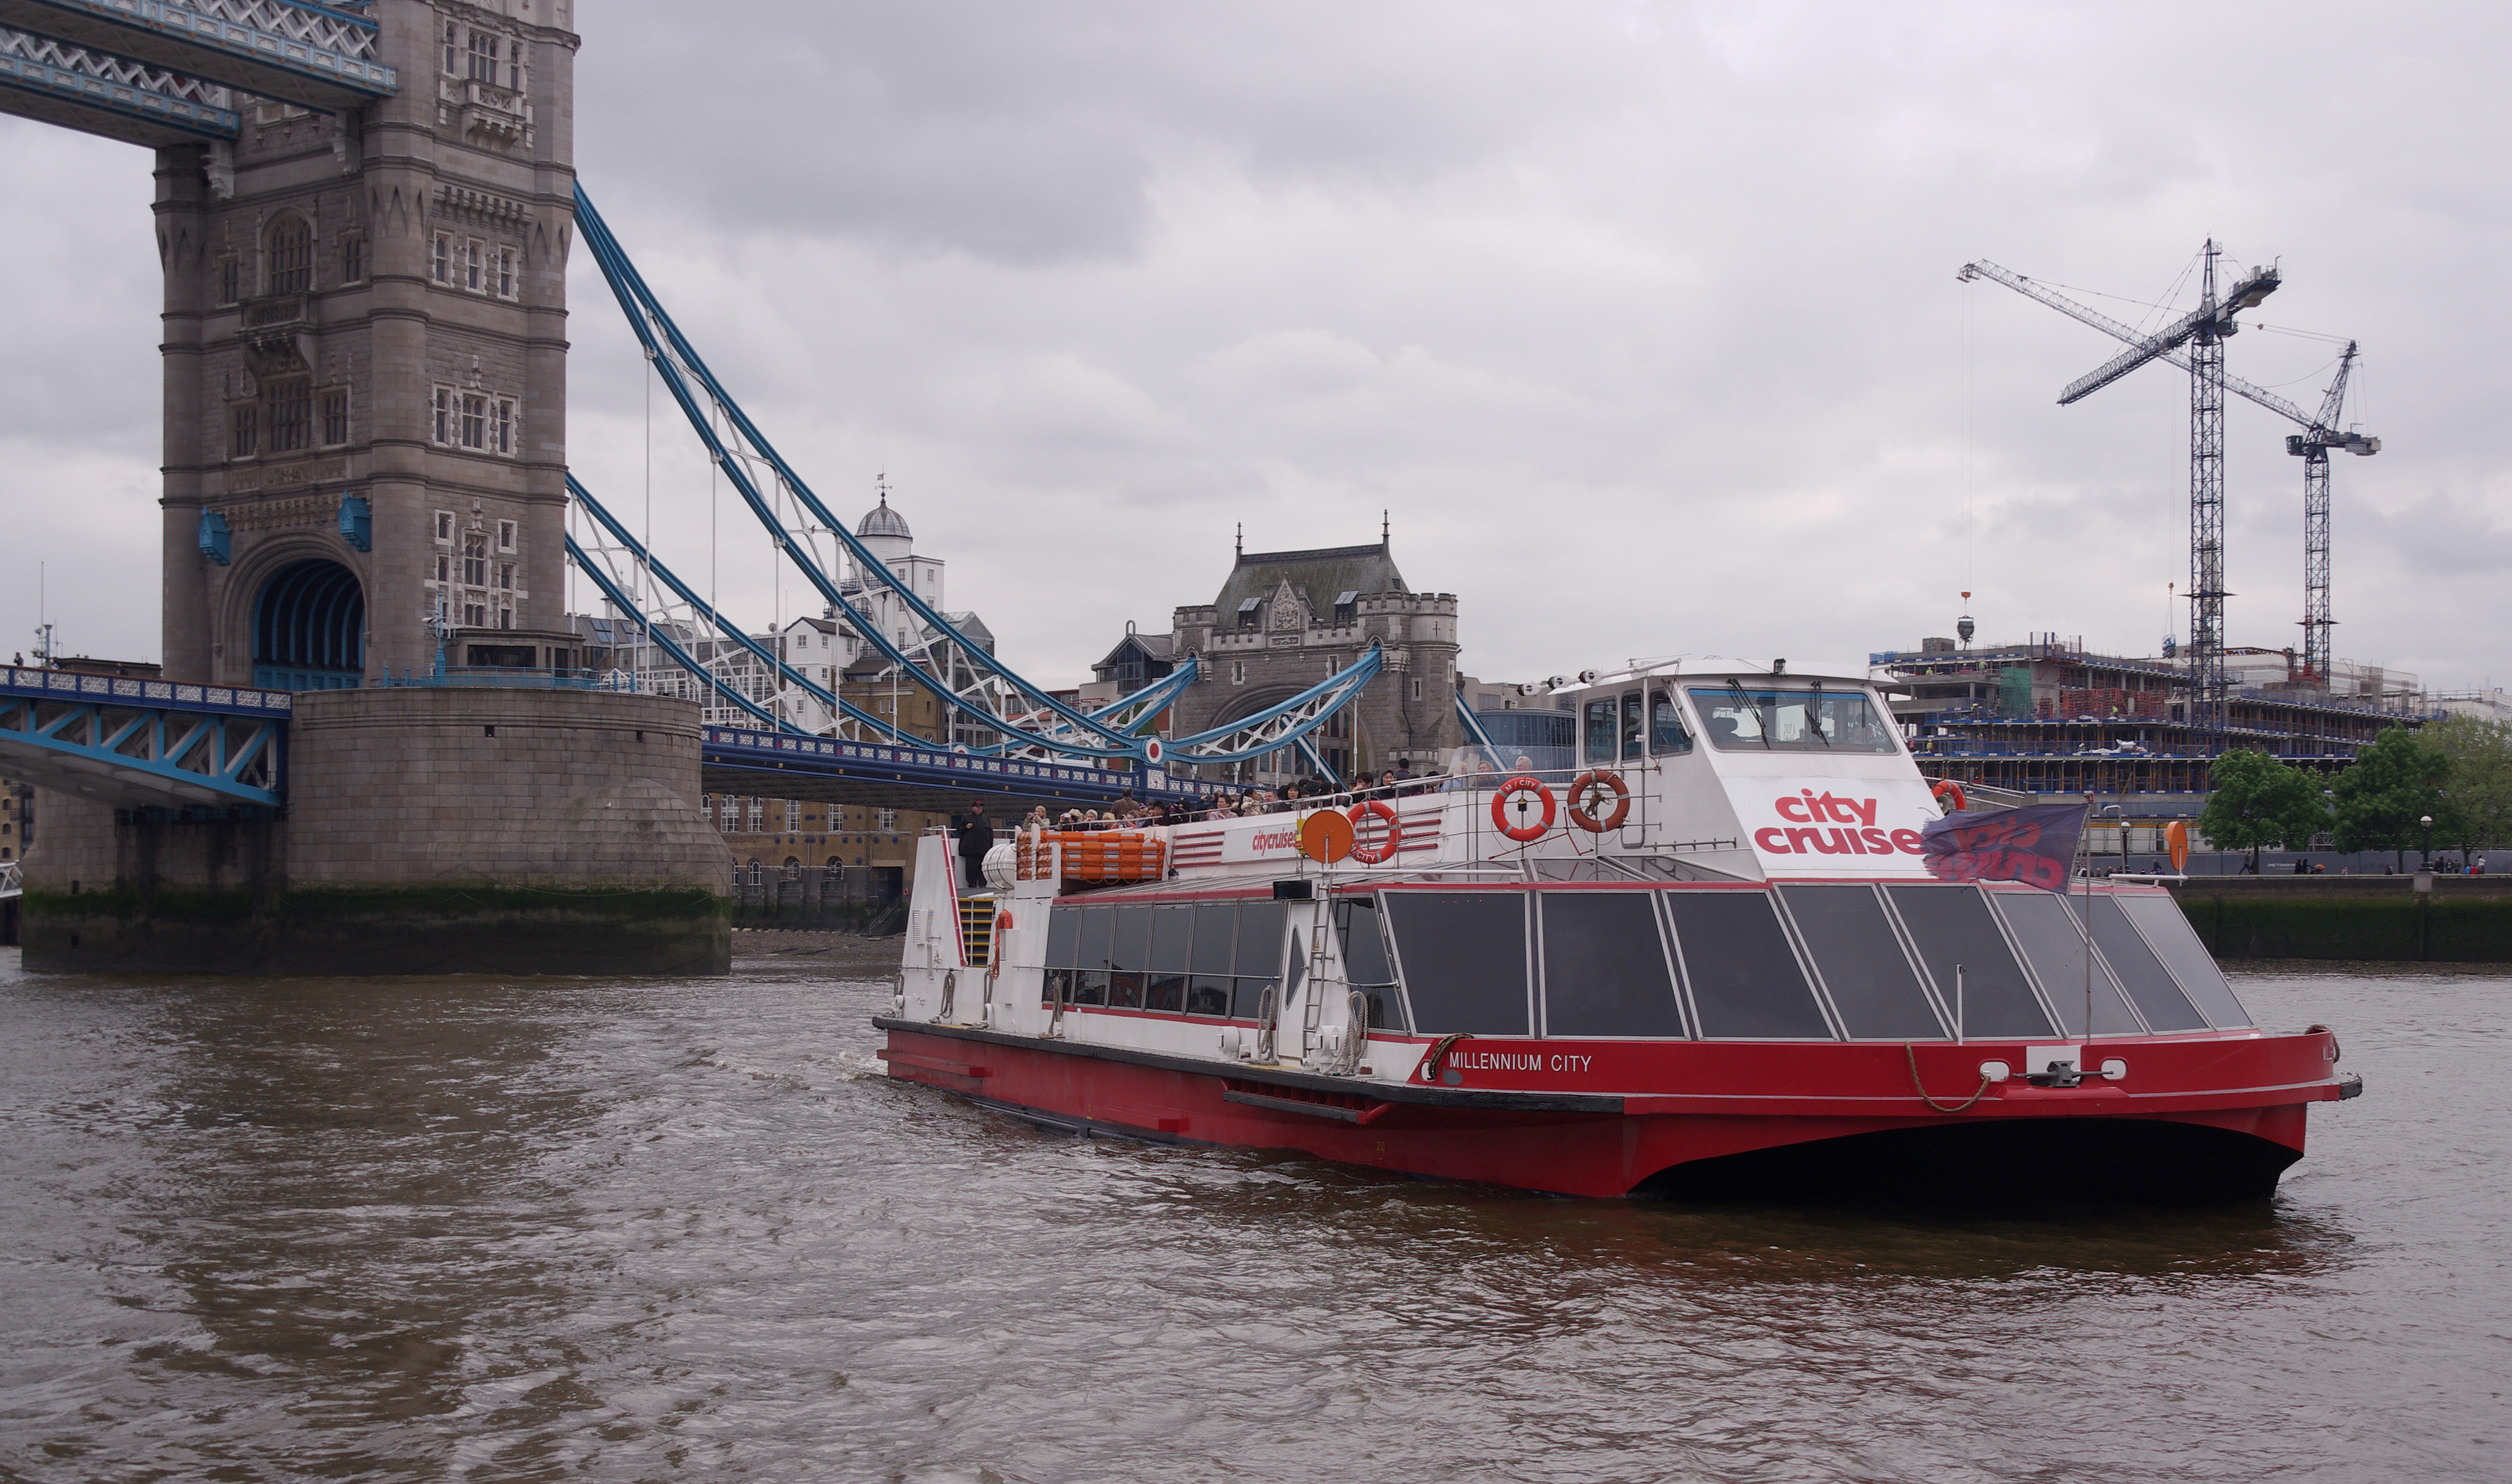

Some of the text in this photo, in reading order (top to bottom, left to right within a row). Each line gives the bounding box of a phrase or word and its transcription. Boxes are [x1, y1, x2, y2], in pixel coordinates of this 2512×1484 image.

[1775, 788, 1877, 827] city
[1356, 851, 1375, 862] CITY
[1449, 1052, 1592, 1072] MILLENNIUM CITY
